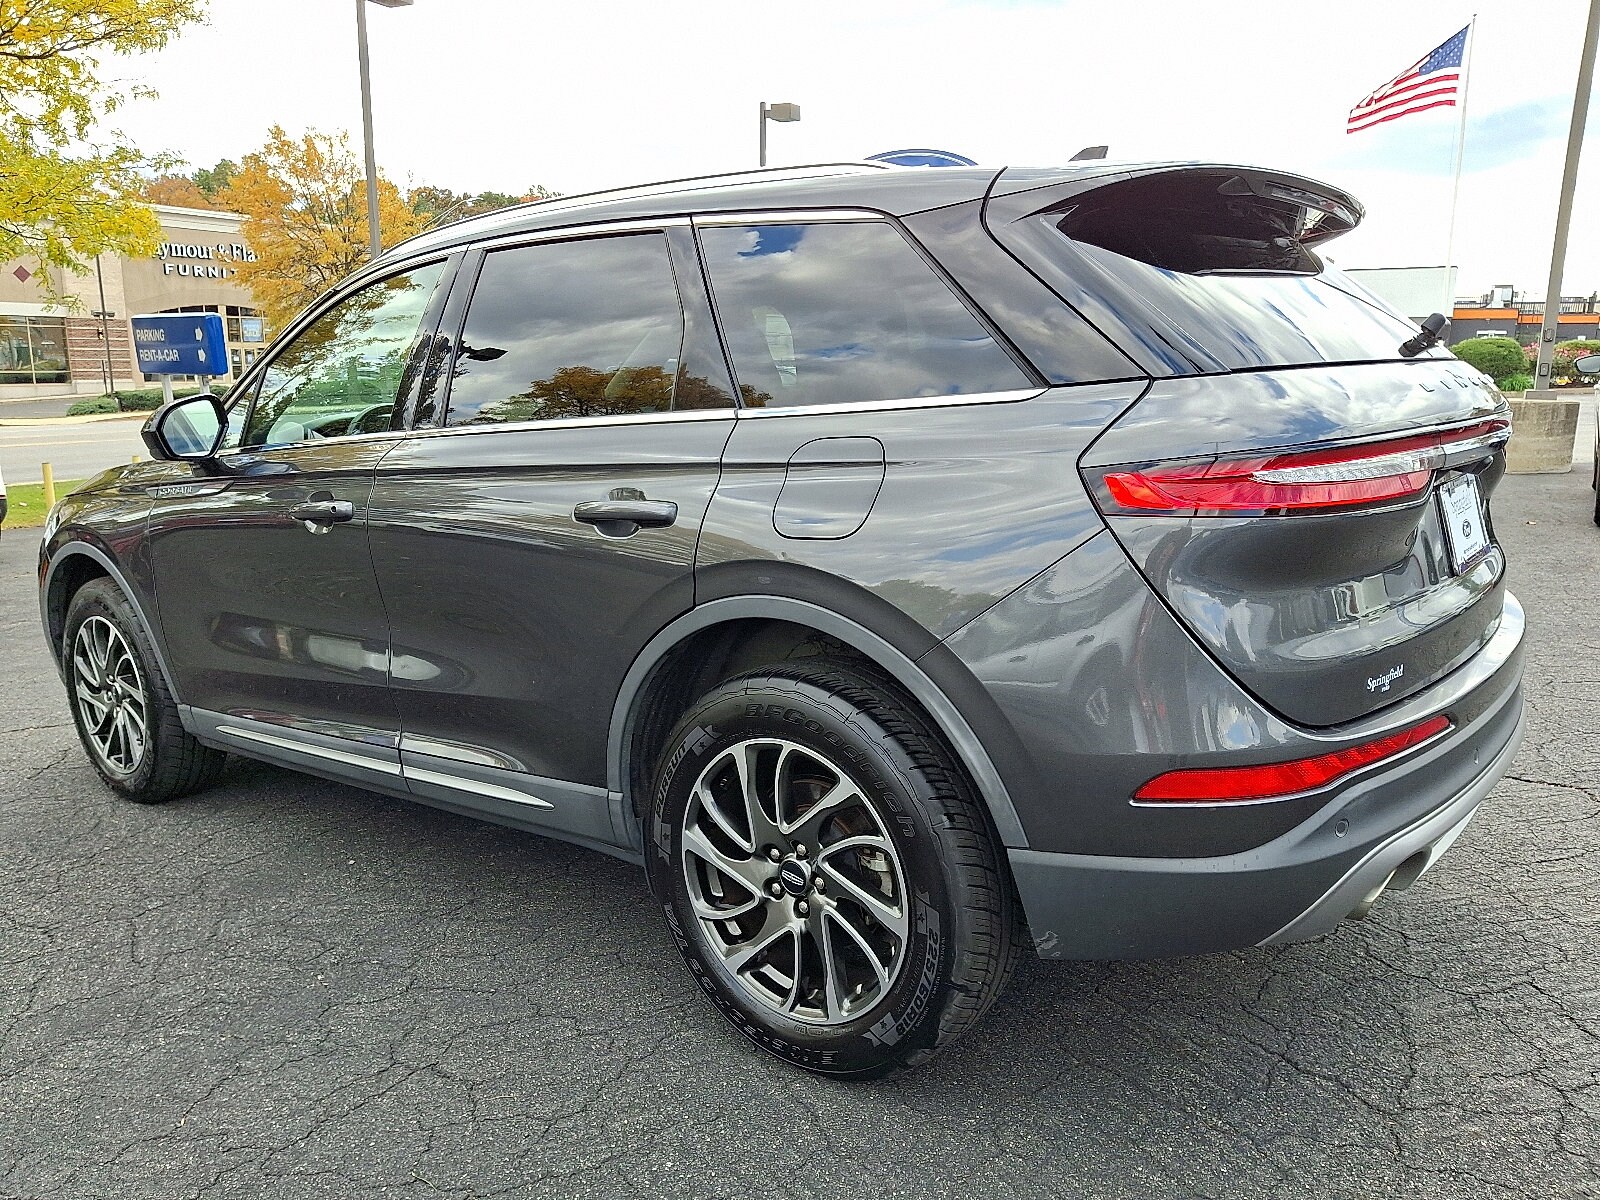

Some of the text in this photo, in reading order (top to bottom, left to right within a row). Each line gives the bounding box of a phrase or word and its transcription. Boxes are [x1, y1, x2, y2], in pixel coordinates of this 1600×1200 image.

[155, 242, 216, 260] aymour
[230, 243, 260, 263] Fla
[136, 329, 165, 341] PARKING
[140, 349, 180, 362] RENT-A-CAR
[1367, 663, 1404, 692] Springfield
[744, 702, 917, 839] BFGoodrich
[894, 926, 940, 1037] 225/60R18
